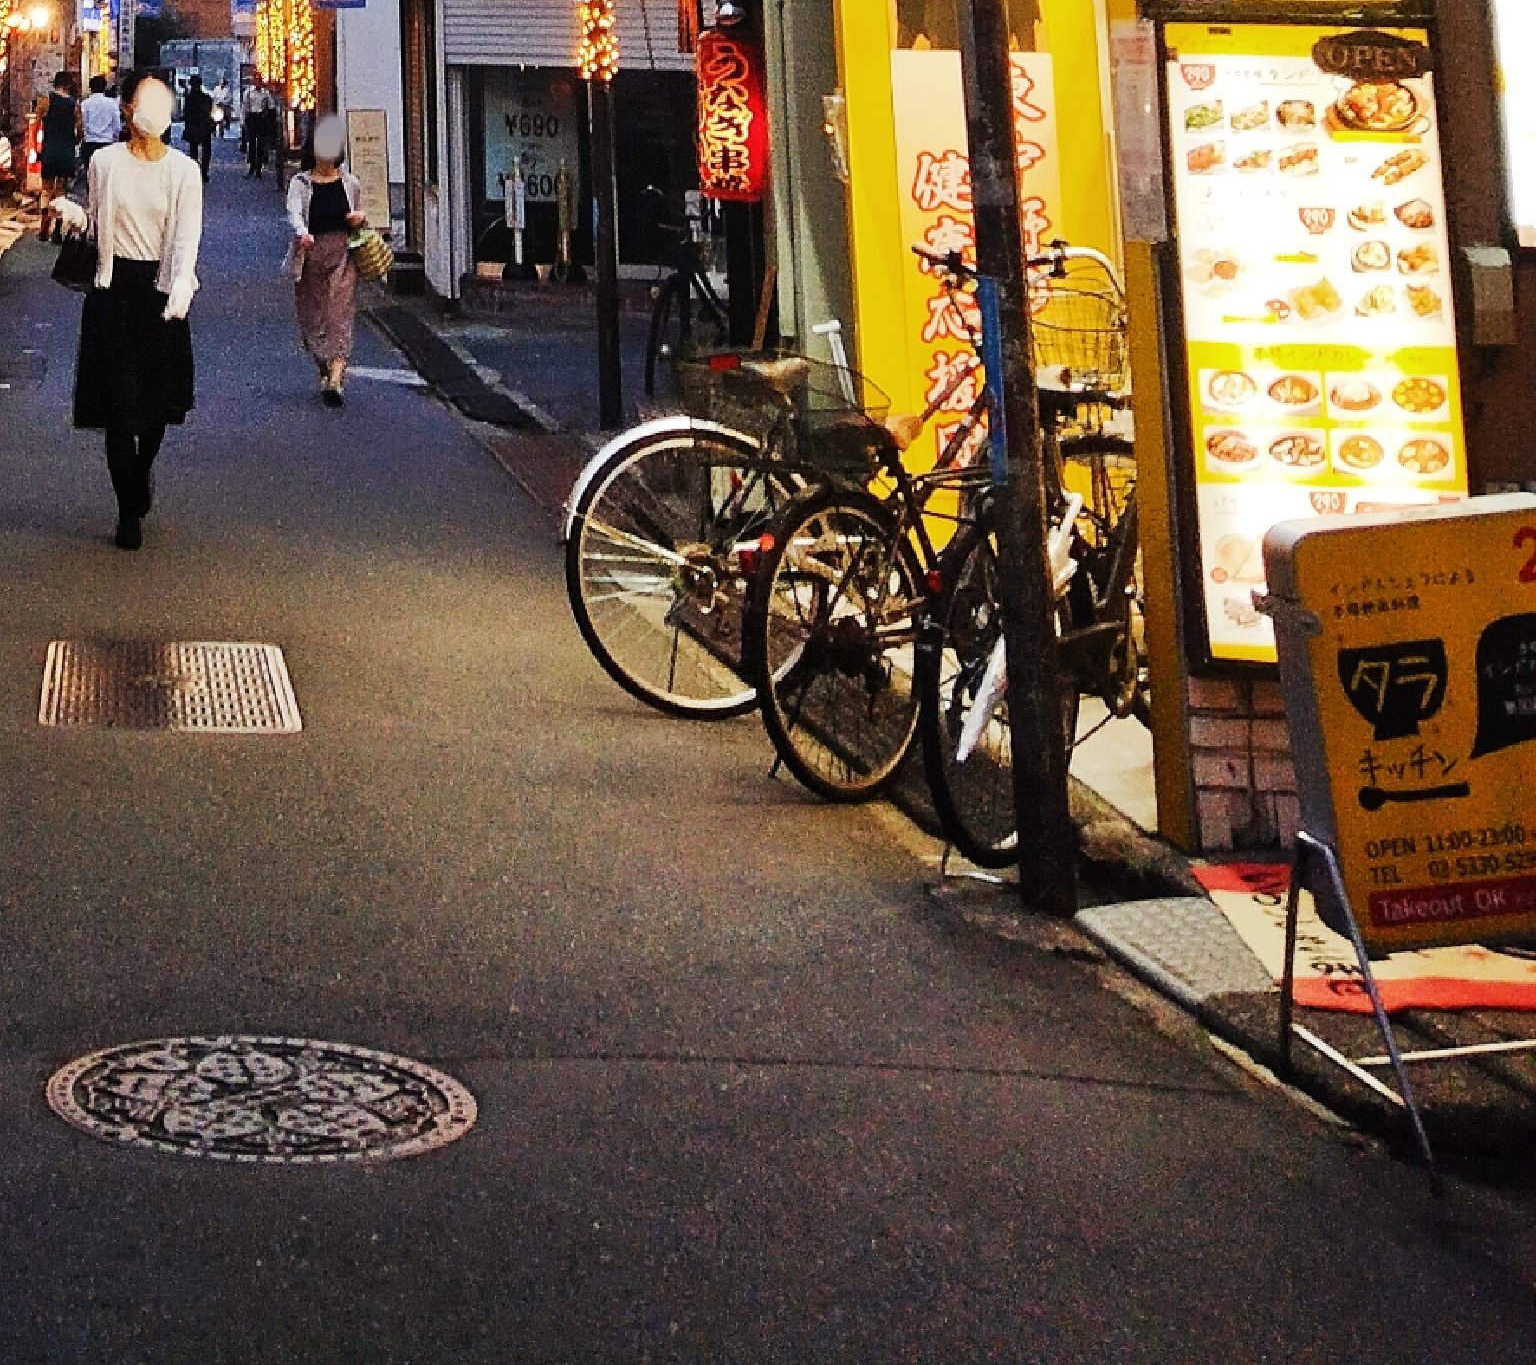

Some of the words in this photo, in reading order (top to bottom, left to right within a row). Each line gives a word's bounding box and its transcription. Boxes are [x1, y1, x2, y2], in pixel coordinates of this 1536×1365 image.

[1327, 43, 1417, 71] OPEN
[1350, 654, 1439, 714] タラ
[1358, 743, 1461, 786] キッチン
[1365, 836, 1417, 859] OPEN
[1368, 865, 1404, 885] TEL
[1377, 893, 1464, 920] Takeout
[1473, 888, 1507, 911] OK
